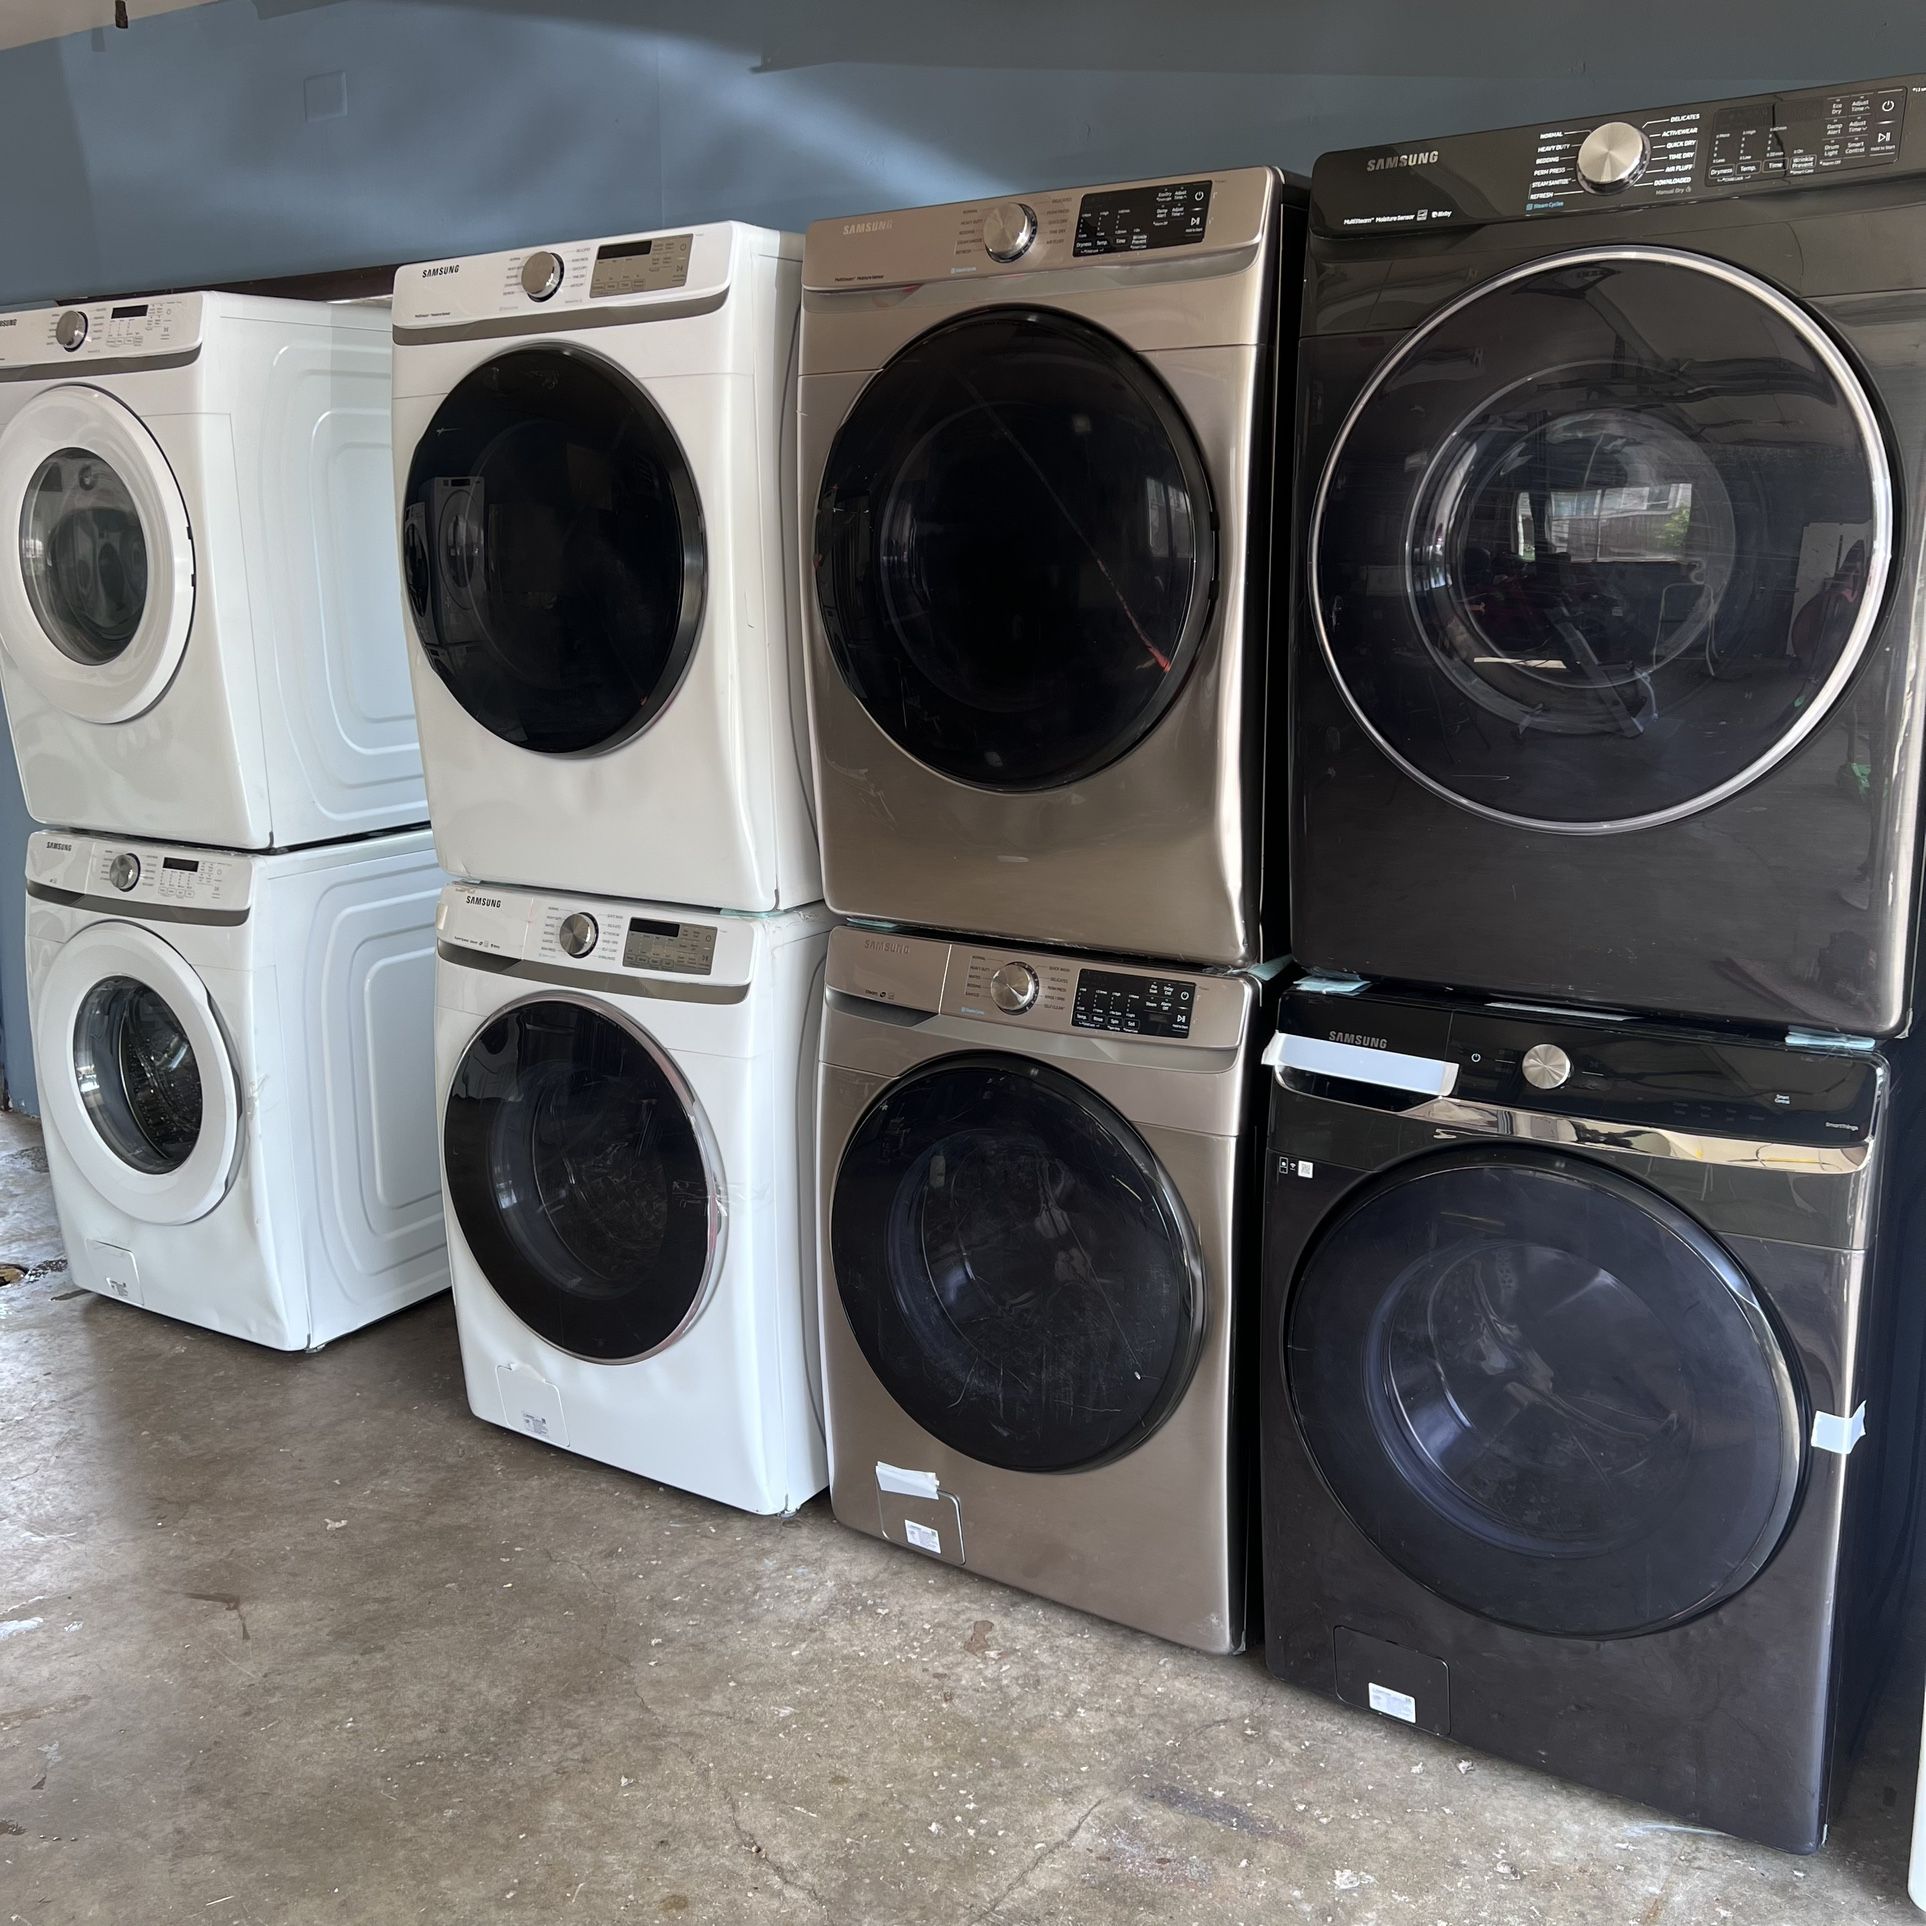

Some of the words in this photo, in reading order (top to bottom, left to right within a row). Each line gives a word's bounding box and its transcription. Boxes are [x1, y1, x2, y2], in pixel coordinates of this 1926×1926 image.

[1670, 113, 1700, 122] DELICATES
[1540, 131, 1563, 139] NORMAL
[1662, 127, 1698, 137] ACTIVEWEAR
[1666, 141, 1684, 149] QUICK
[1367, 151, 1438, 172] SAMSUNG
[1654, 176, 1692, 186] DOWNLOADED
[842, 219, 894, 235] SAMSUNG
[422, 264, 460, 278] SAMSUNG
[46, 841, 72, 851] SAMSUNG
[465, 895, 502, 908] SAMSUNG
[864, 939, 910, 954] SAMSUNG
[1328, 1030, 1388, 1049] SAMSUNG
